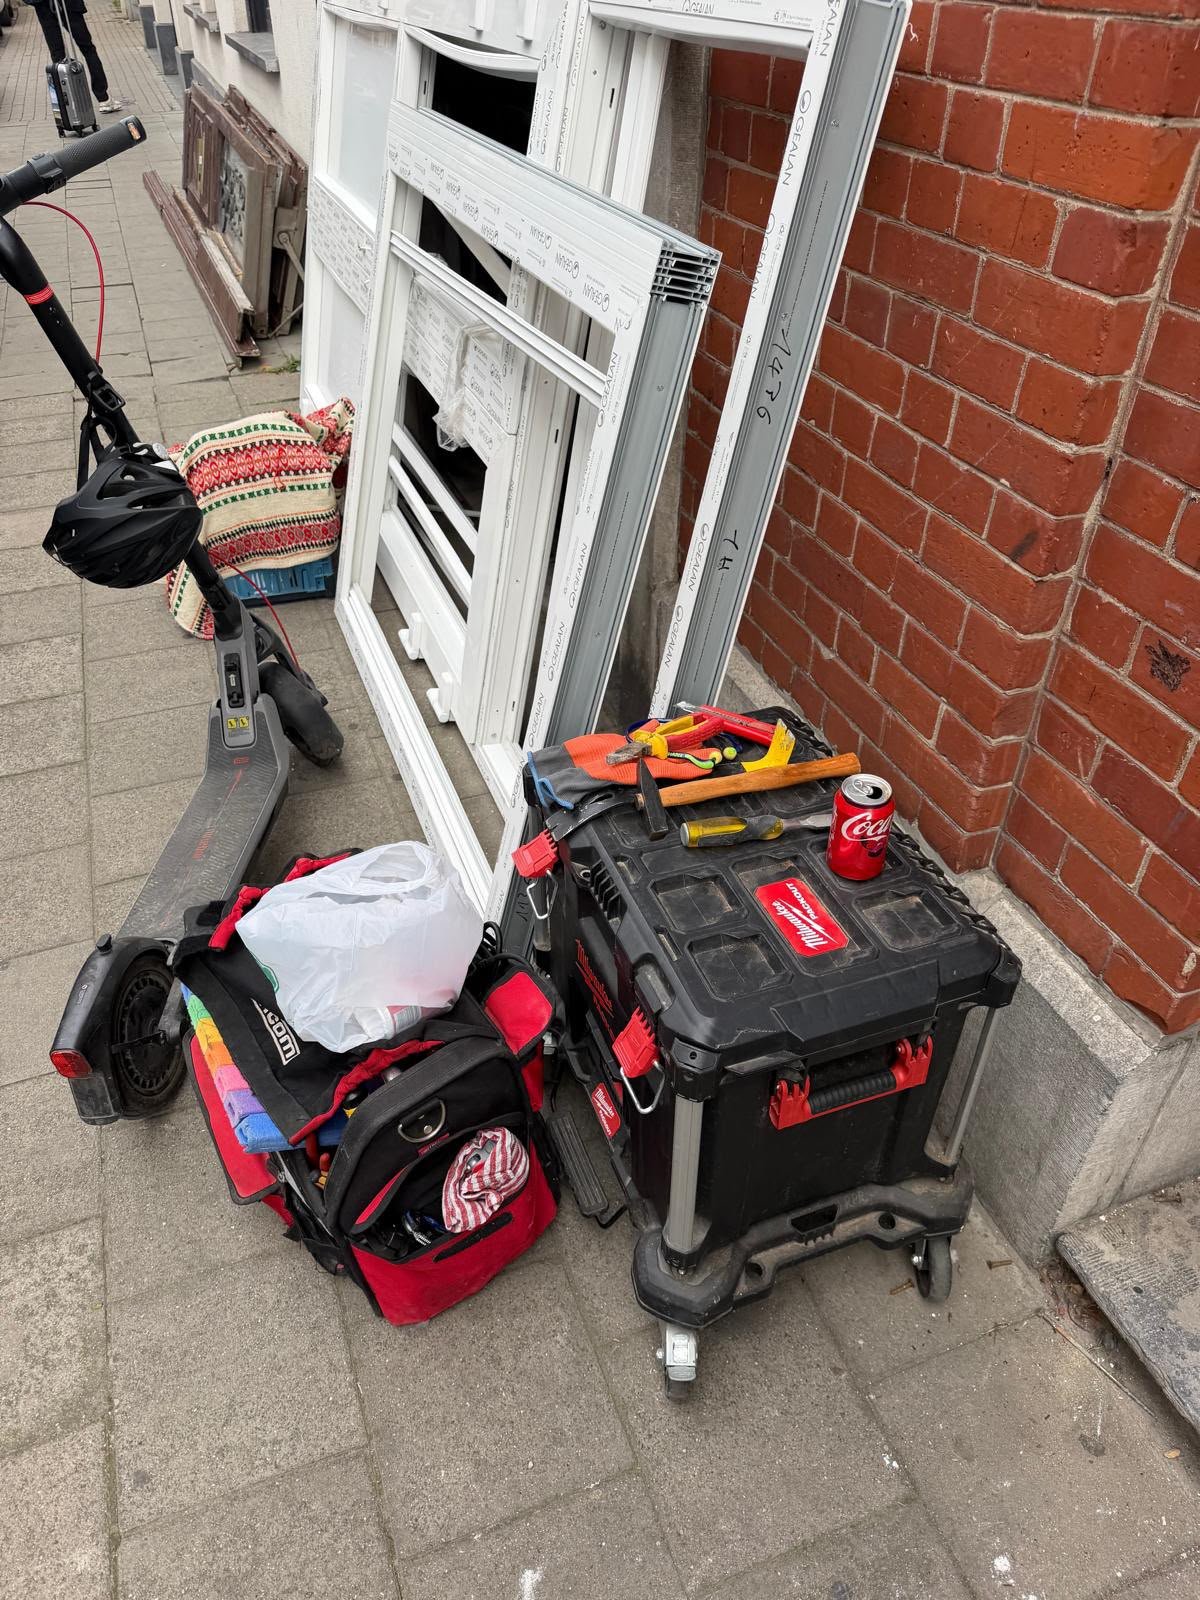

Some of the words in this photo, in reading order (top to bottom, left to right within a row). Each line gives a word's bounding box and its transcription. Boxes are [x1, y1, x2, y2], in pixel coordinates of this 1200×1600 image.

[820, 0, 841, 57] EALAN
[782, 116, 804, 186] GEALAN
[583, 283, 602, 306] GEALAN
[601, 351, 619, 406] GEALAN
[573, 543, 588, 596] GEALAN
[688, 539, 709, 592] GEALAN
[551, 621, 566, 668] GEALAN
[664, 621, 681, 668] GEALAN
[532, 692, 545, 735] GEALAN
[772, 899, 828, 950] Milwaukee
[786, 883, 818, 920] PACKOUT
